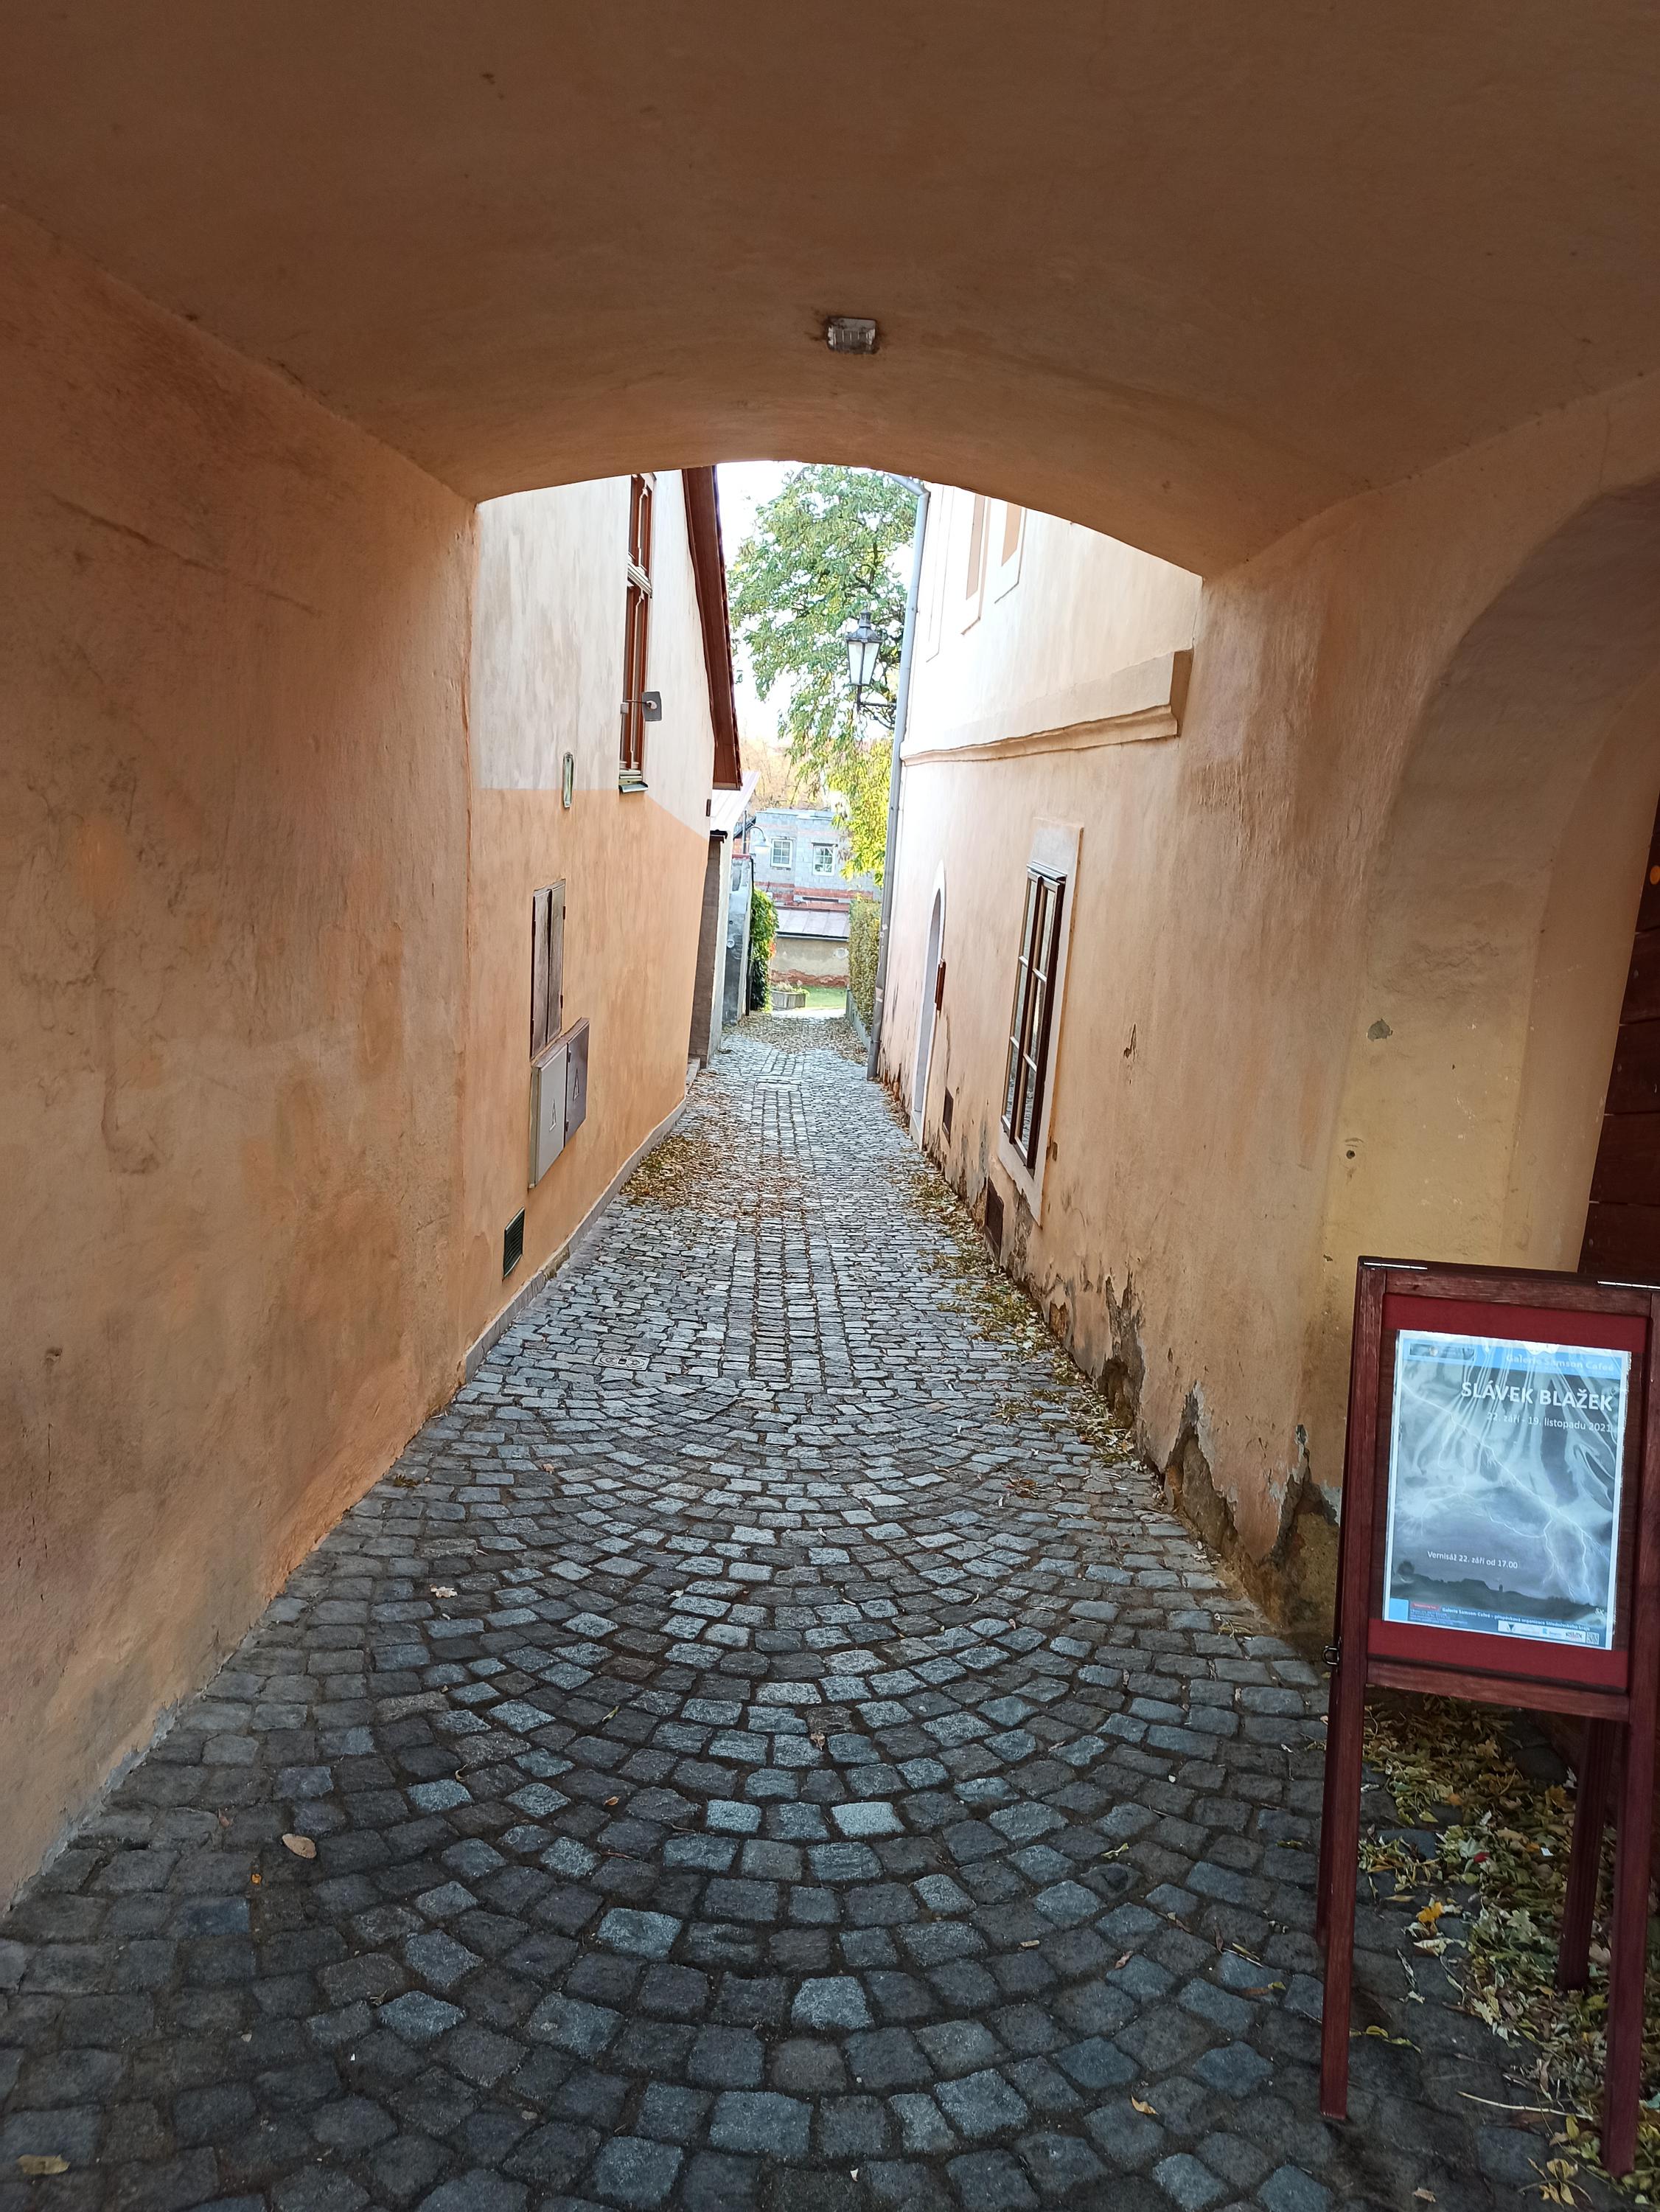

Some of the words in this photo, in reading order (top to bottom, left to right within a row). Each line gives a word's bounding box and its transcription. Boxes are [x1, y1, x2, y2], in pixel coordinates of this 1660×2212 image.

[1462, 1380, 1534, 1404] SLÁVEK
[1540, 1388, 1613, 1411] BLAŽEK
[1503, 1415, 1520, 1425] září
[1528, 1416, 1541, 1426] 19.
[1544, 1419, 1586, 1431] listopadu
[1588, 1422, 1611, 1433] 2021
[1427, 1551, 1457, 1562] Vernisáž
[1459, 1554, 1470, 1562] 22.
[1471, 1557, 1485, 1565] září
[1498, 1559, 1518, 1569] 17.00
